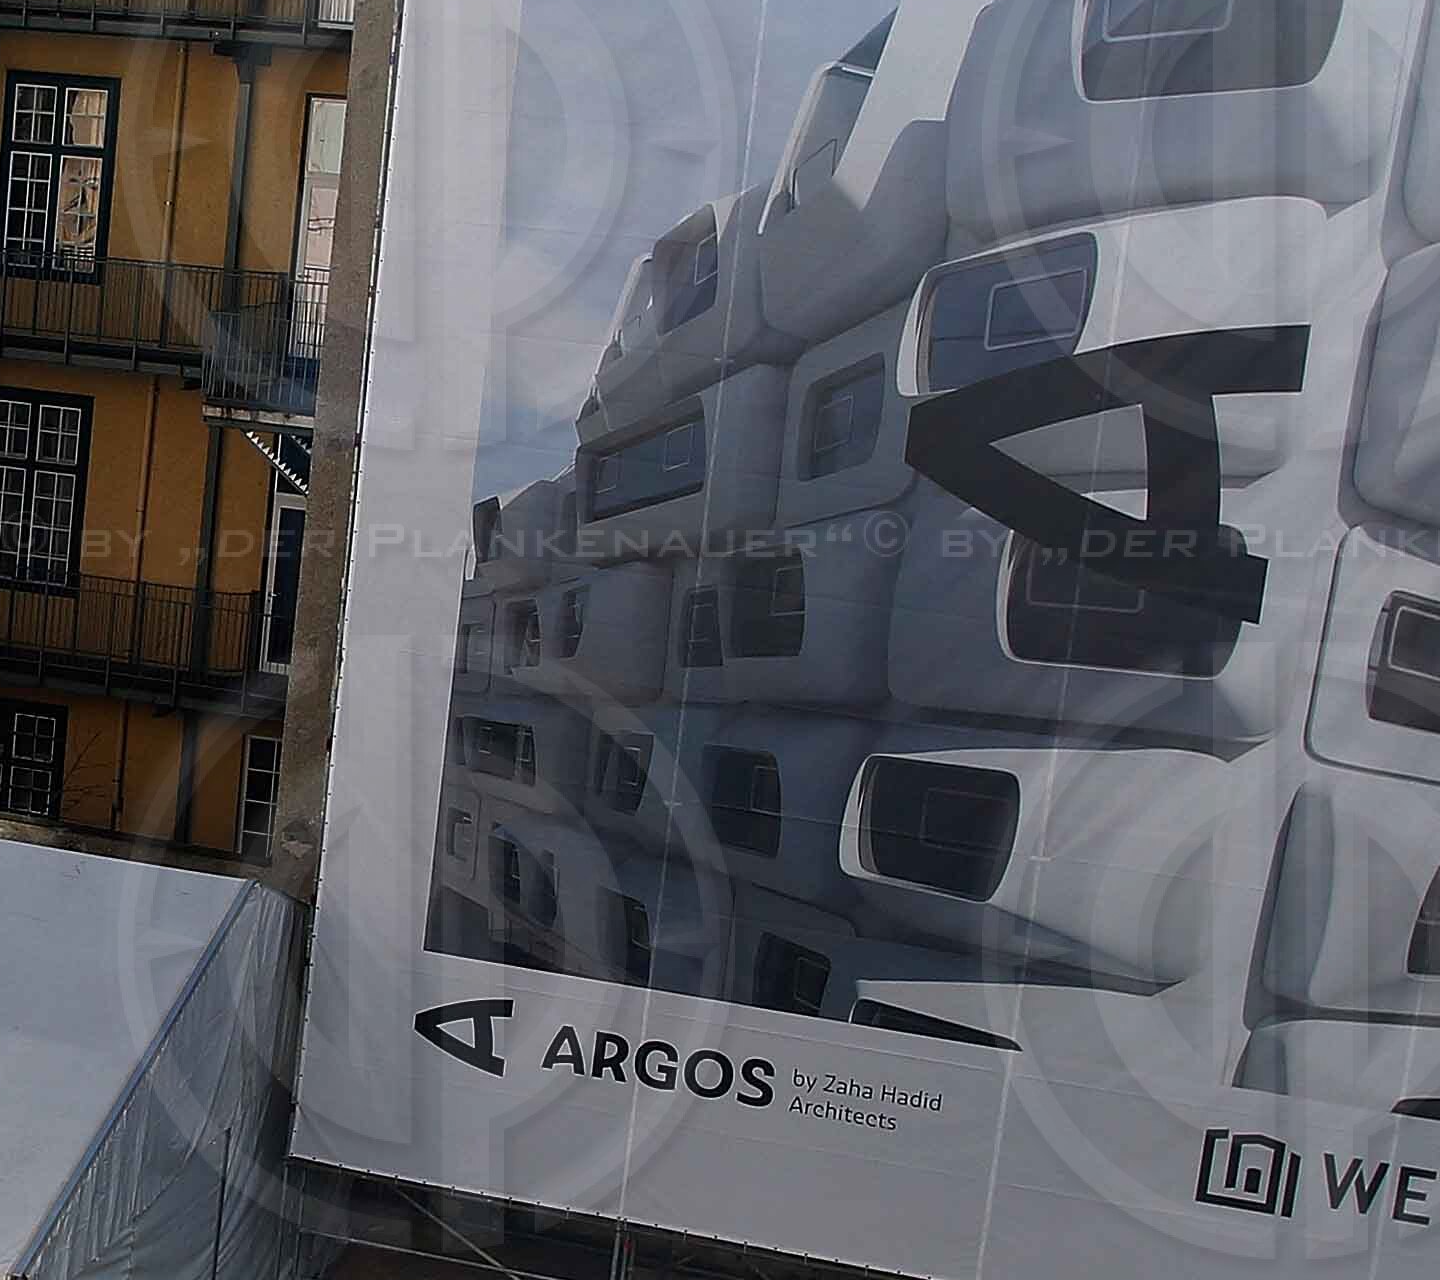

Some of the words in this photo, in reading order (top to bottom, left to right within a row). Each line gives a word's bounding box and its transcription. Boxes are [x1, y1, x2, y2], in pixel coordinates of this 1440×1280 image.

[540, 1024, 776, 1108] ARGOS
[792, 1068, 817, 1094] by
[821, 1074, 874, 1100] Zaha
[880, 1082, 943, 1112] Hadid
[788, 1096, 898, 1131] Architects
